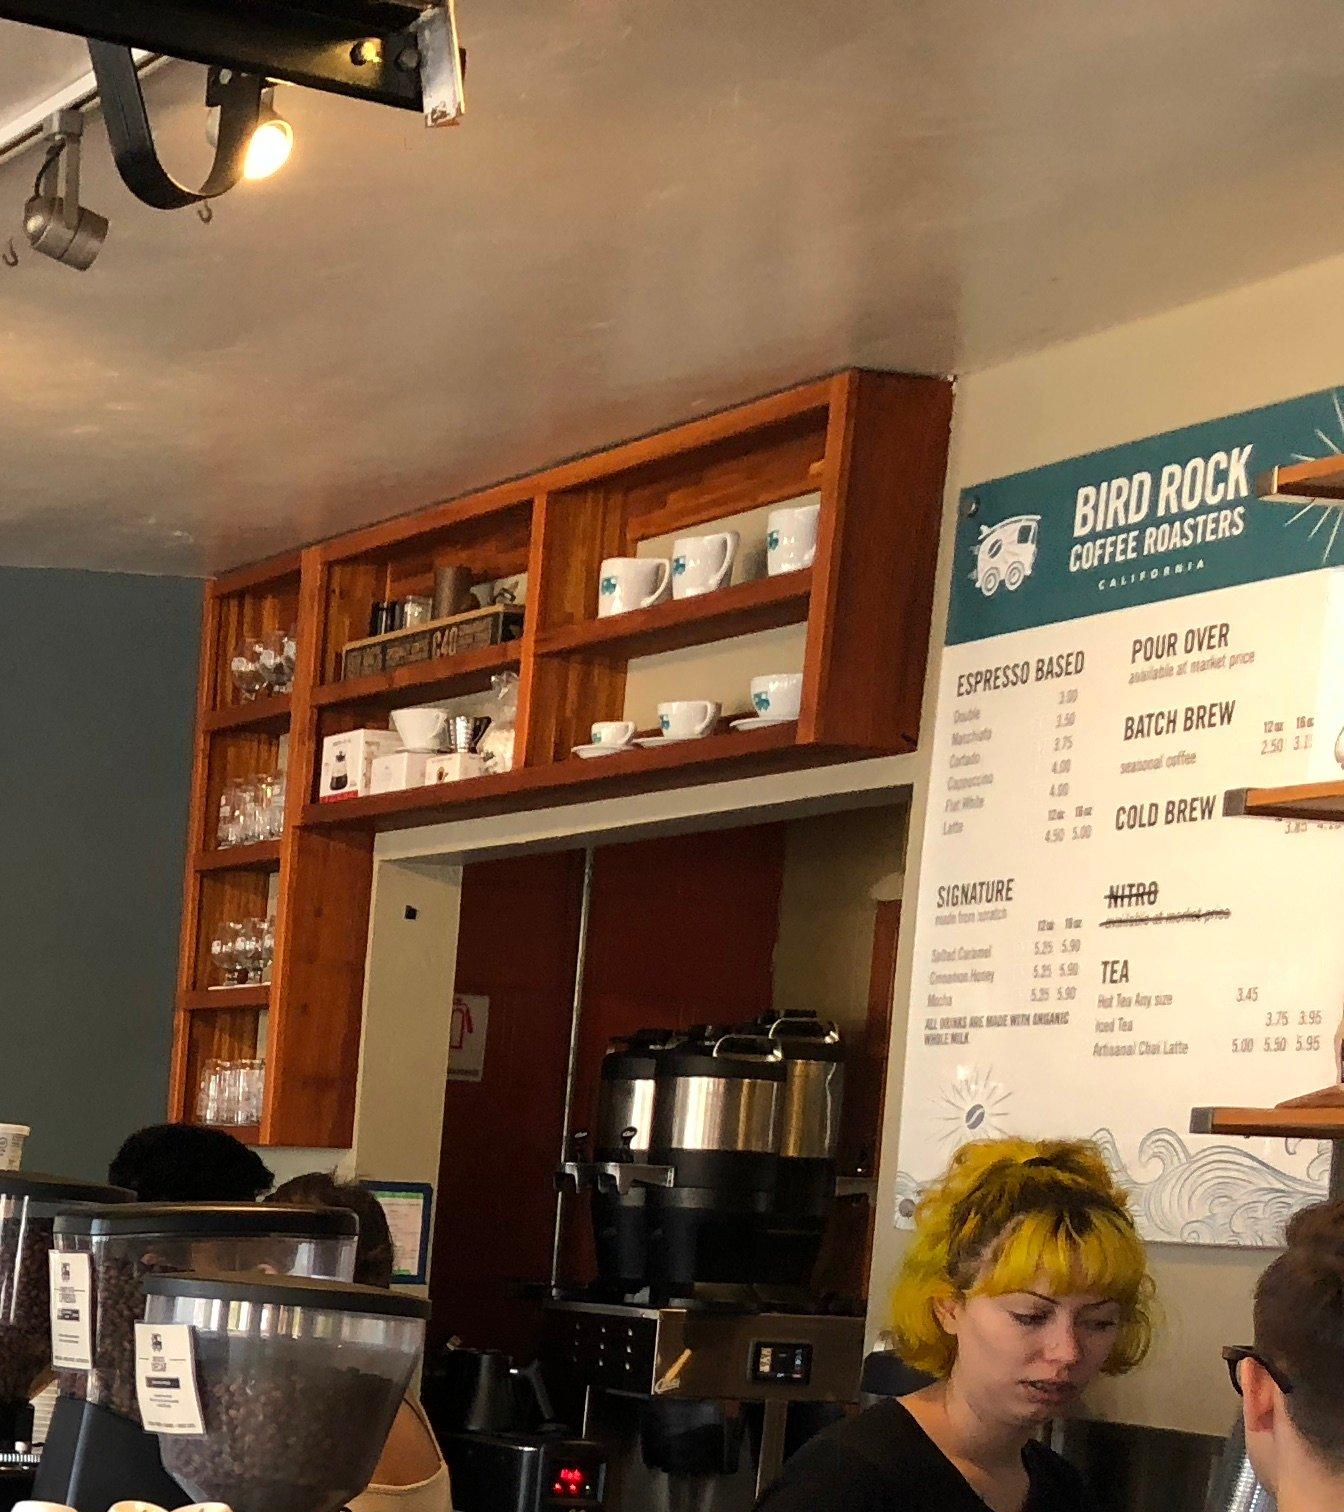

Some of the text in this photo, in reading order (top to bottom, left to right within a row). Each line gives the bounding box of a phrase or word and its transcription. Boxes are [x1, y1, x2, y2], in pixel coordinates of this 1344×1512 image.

[1073, 444, 1254, 538] BIRD ROCK
[1069, 506, 1246, 572] COFFEE ROASTERS
[1098, 559, 1205, 591] CALIFORNIA
[1131, 623, 1230, 664] POUR OVER
[957, 650, 1085, 697] ESPRESSO BASED
[1123, 700, 1236, 741] BATCH BREW
[1115, 795, 1217, 831] COLD BREW
[937, 878, 1015, 908] SIGNATURE
[1106, 881, 1159, 909] NITRO
[1101, 959, 1130, 984] TEA
